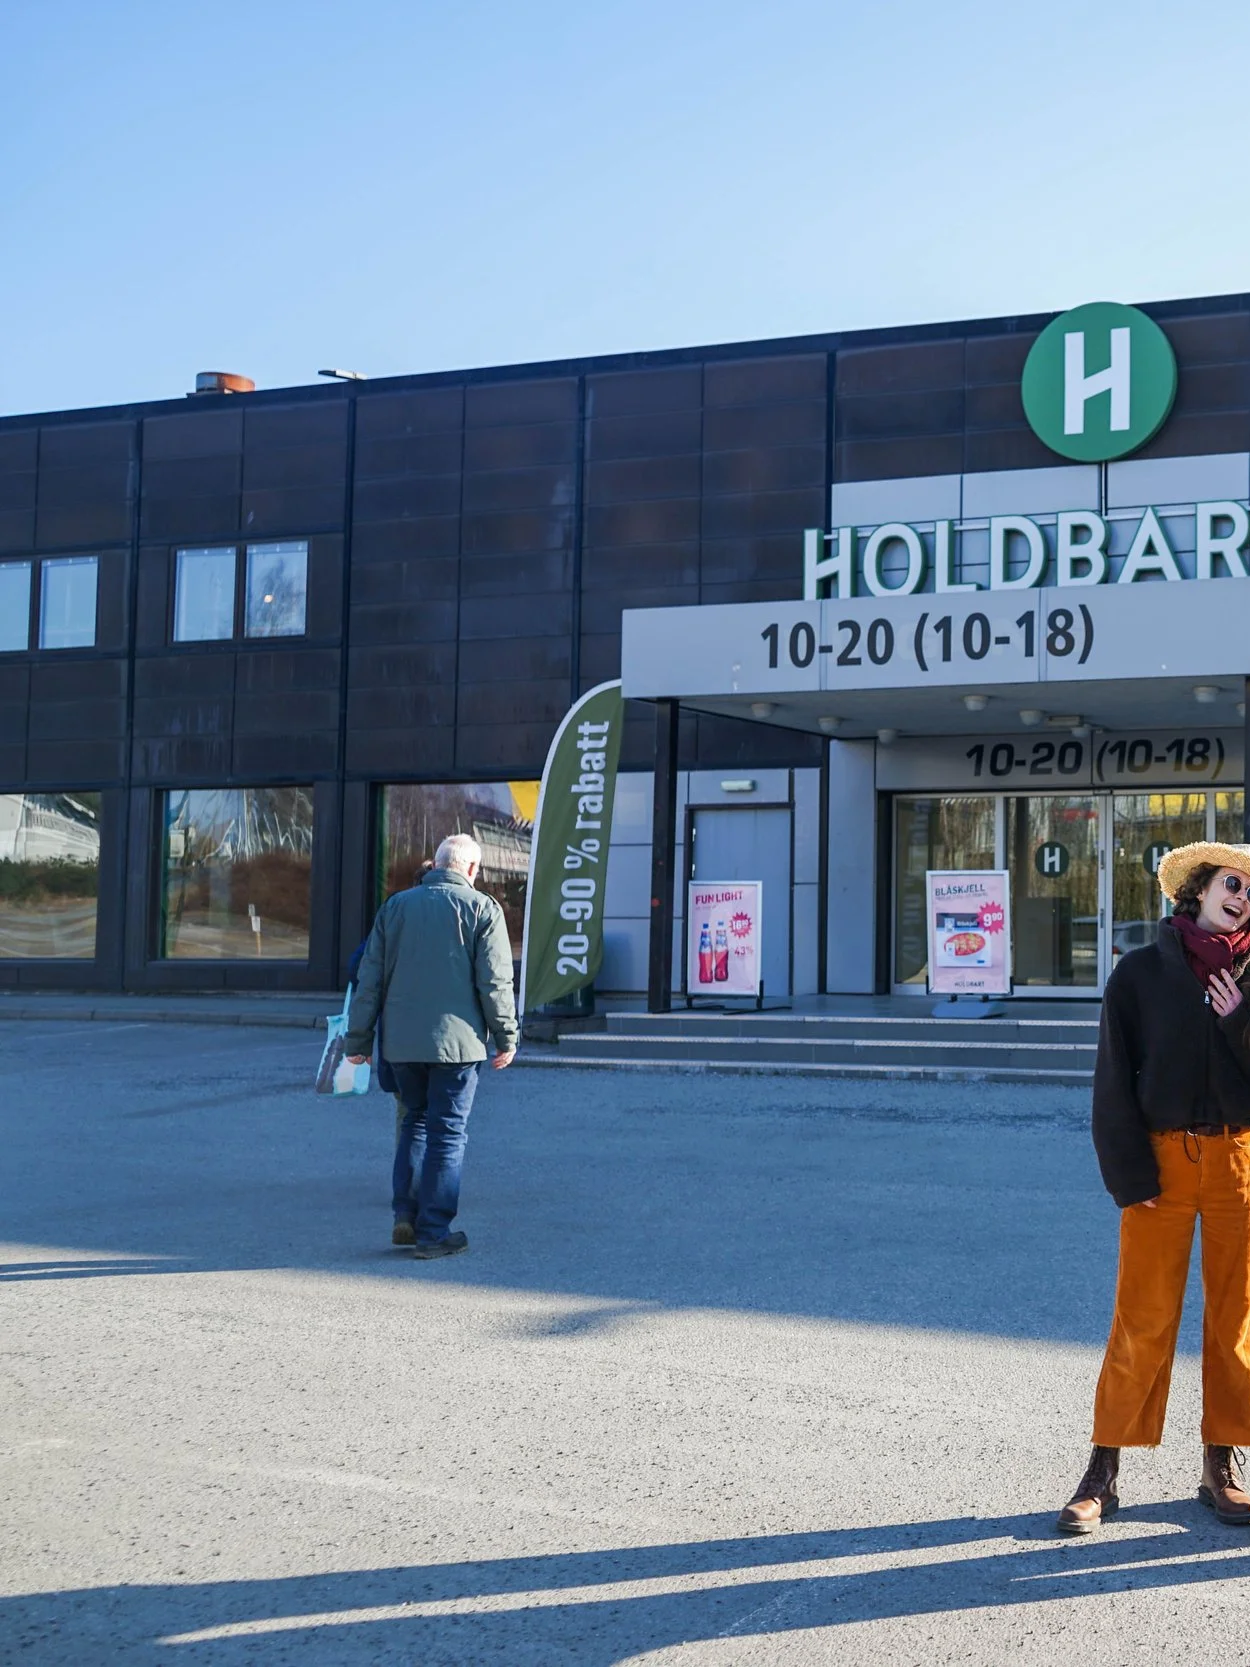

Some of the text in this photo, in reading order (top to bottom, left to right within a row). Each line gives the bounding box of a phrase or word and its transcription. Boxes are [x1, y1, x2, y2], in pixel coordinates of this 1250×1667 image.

[1064, 327, 1130, 435] H
[760, 603, 1095, 672] 10-20 (10-18)
[571, 720, 610, 830] rabatt
[966, 737, 1225, 781] 10-20 (10-18)
[1044, 847, 1061, 873] H
[556, 877, 596, 976] 20-90
[695, 890, 743, 905] FUN LIGHT
